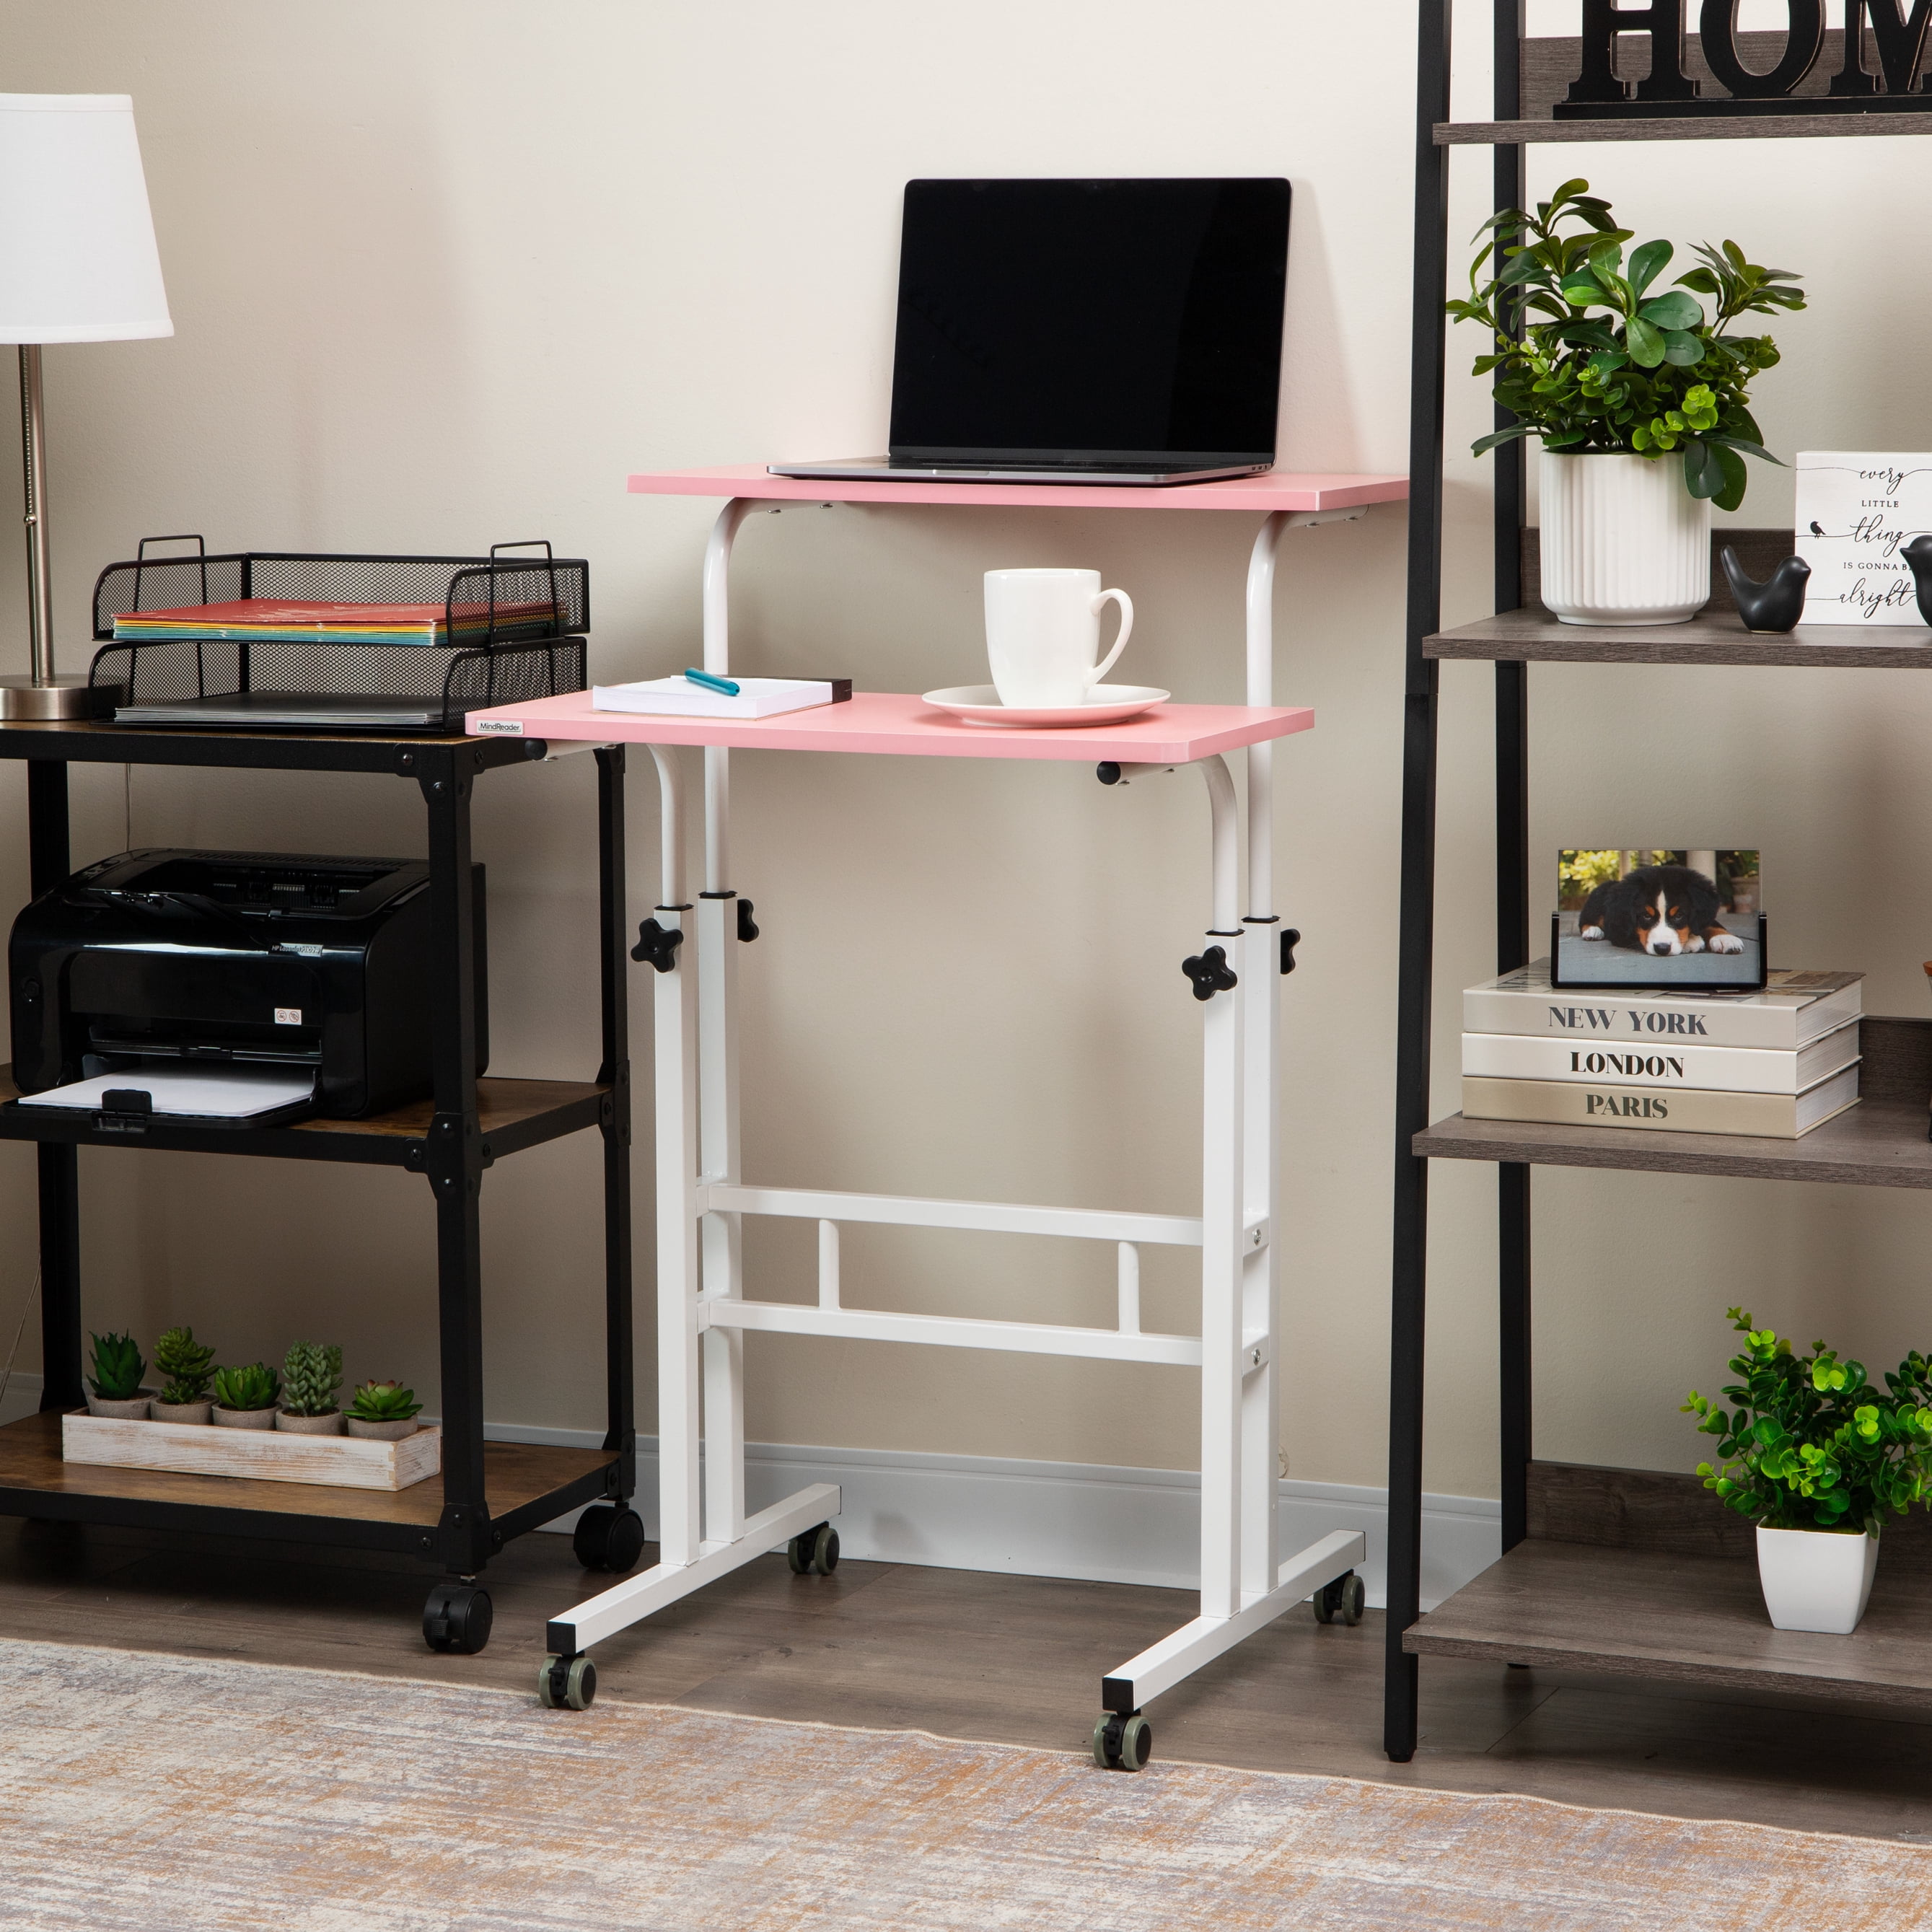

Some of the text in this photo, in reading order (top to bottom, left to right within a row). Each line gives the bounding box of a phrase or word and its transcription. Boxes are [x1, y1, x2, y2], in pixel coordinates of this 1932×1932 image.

[1859, 467, 1905, 495] every
[1861, 499, 1900, 508] LITTLE
[1850, 514, 1905, 558] thing
[1858, 562, 1898, 571] GONNA
[1840, 577, 1916, 619] alright
[478, 722, 521, 732] MindReader
[1548, 1006, 1708, 1035] NEW YORK
[1571, 1051, 1684, 1078] LONDON
[1586, 1094, 1668, 1119] PARIS
